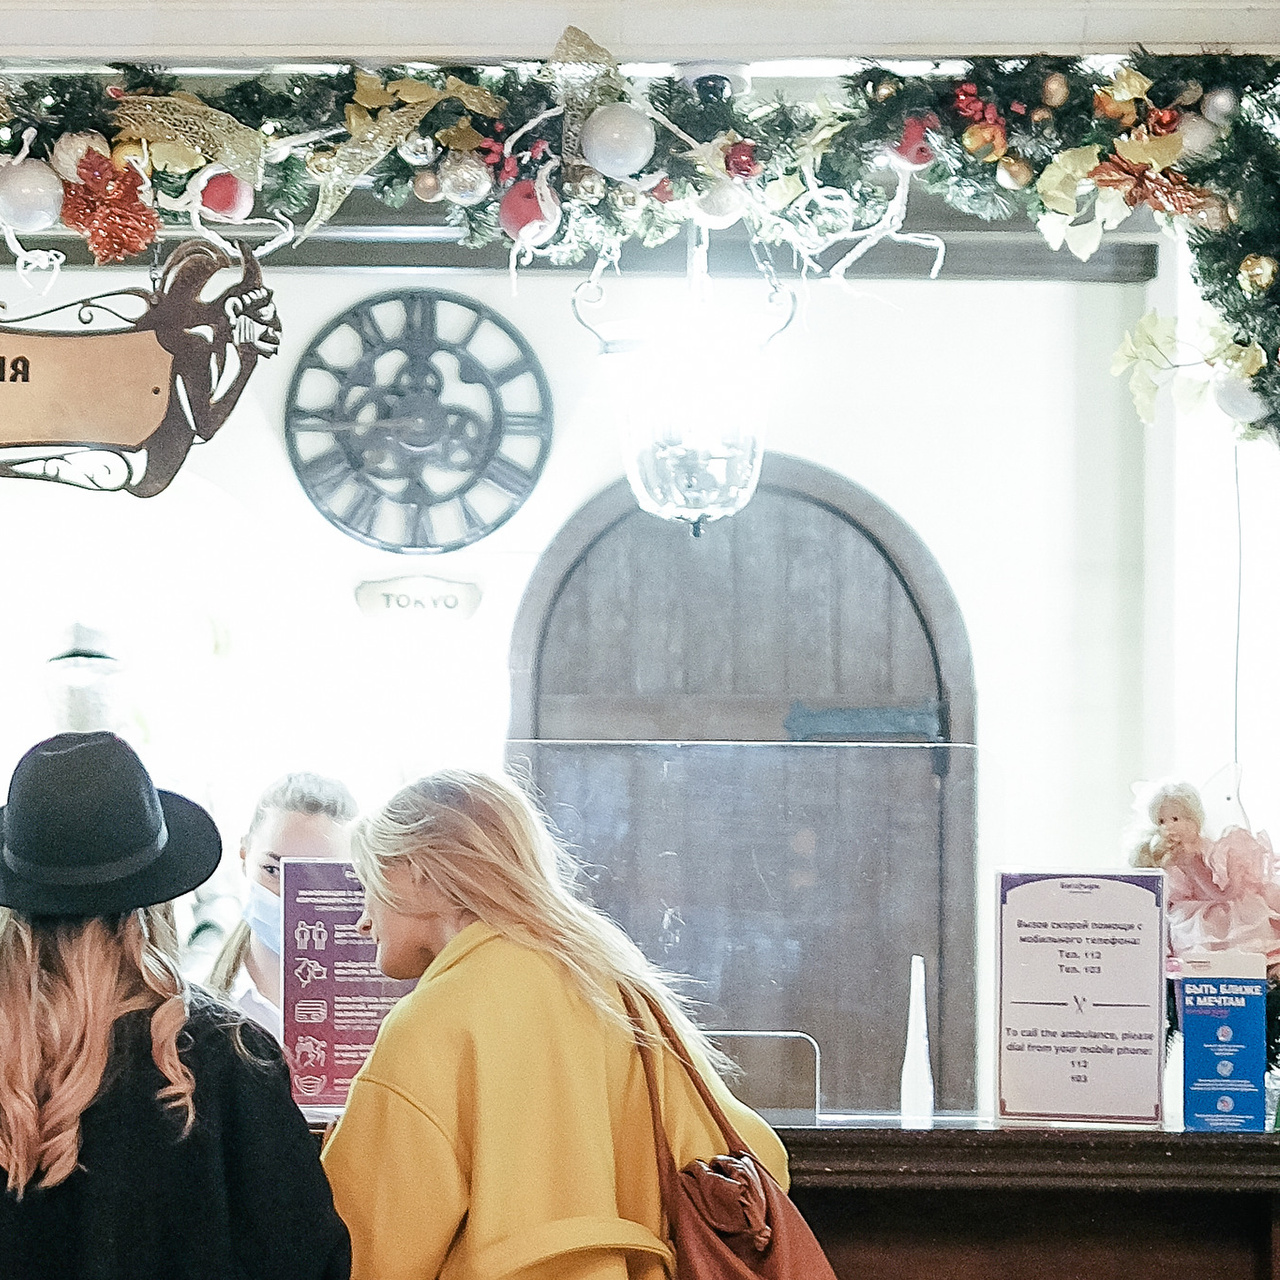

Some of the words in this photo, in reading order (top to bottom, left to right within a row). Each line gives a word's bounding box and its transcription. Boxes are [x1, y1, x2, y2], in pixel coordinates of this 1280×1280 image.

[380, 593, 459, 609] TOKYO
[1051, 920, 1088, 931] скорой
[1091, 922, 1134, 932] помощи
[1019, 934, 1082, 945] мобильного
[1058, 950, 1080, 959] Тел.
[1084, 951, 1102, 959] 112
[1058, 964, 1080, 973] Тел.
[1185, 984, 1217, 995] БЫТЬ
[1220, 984, 1263, 996] БЛИЖЕ
[1185, 996, 1194, 1006] К
[1197, 997, 1246, 1007] МЕЧТАМ
[1005, 1028, 1018, 1037] To
[1021, 1028, 1037, 1037] call
[1041, 1029, 1057, 1038] the
[1060, 1030, 1118, 1040] ambulance,
[1122, 1031, 1155, 1041] please
[1006, 1042, 1024, 1052] dial
[1027, 1043, 1052, 1052] from
[1054, 1045, 1077, 1055] your
[1080, 1044, 1114, 1054] mobile
[1071, 1060, 1088, 1069] 112
[1071, 1074, 1088, 1083] 103
